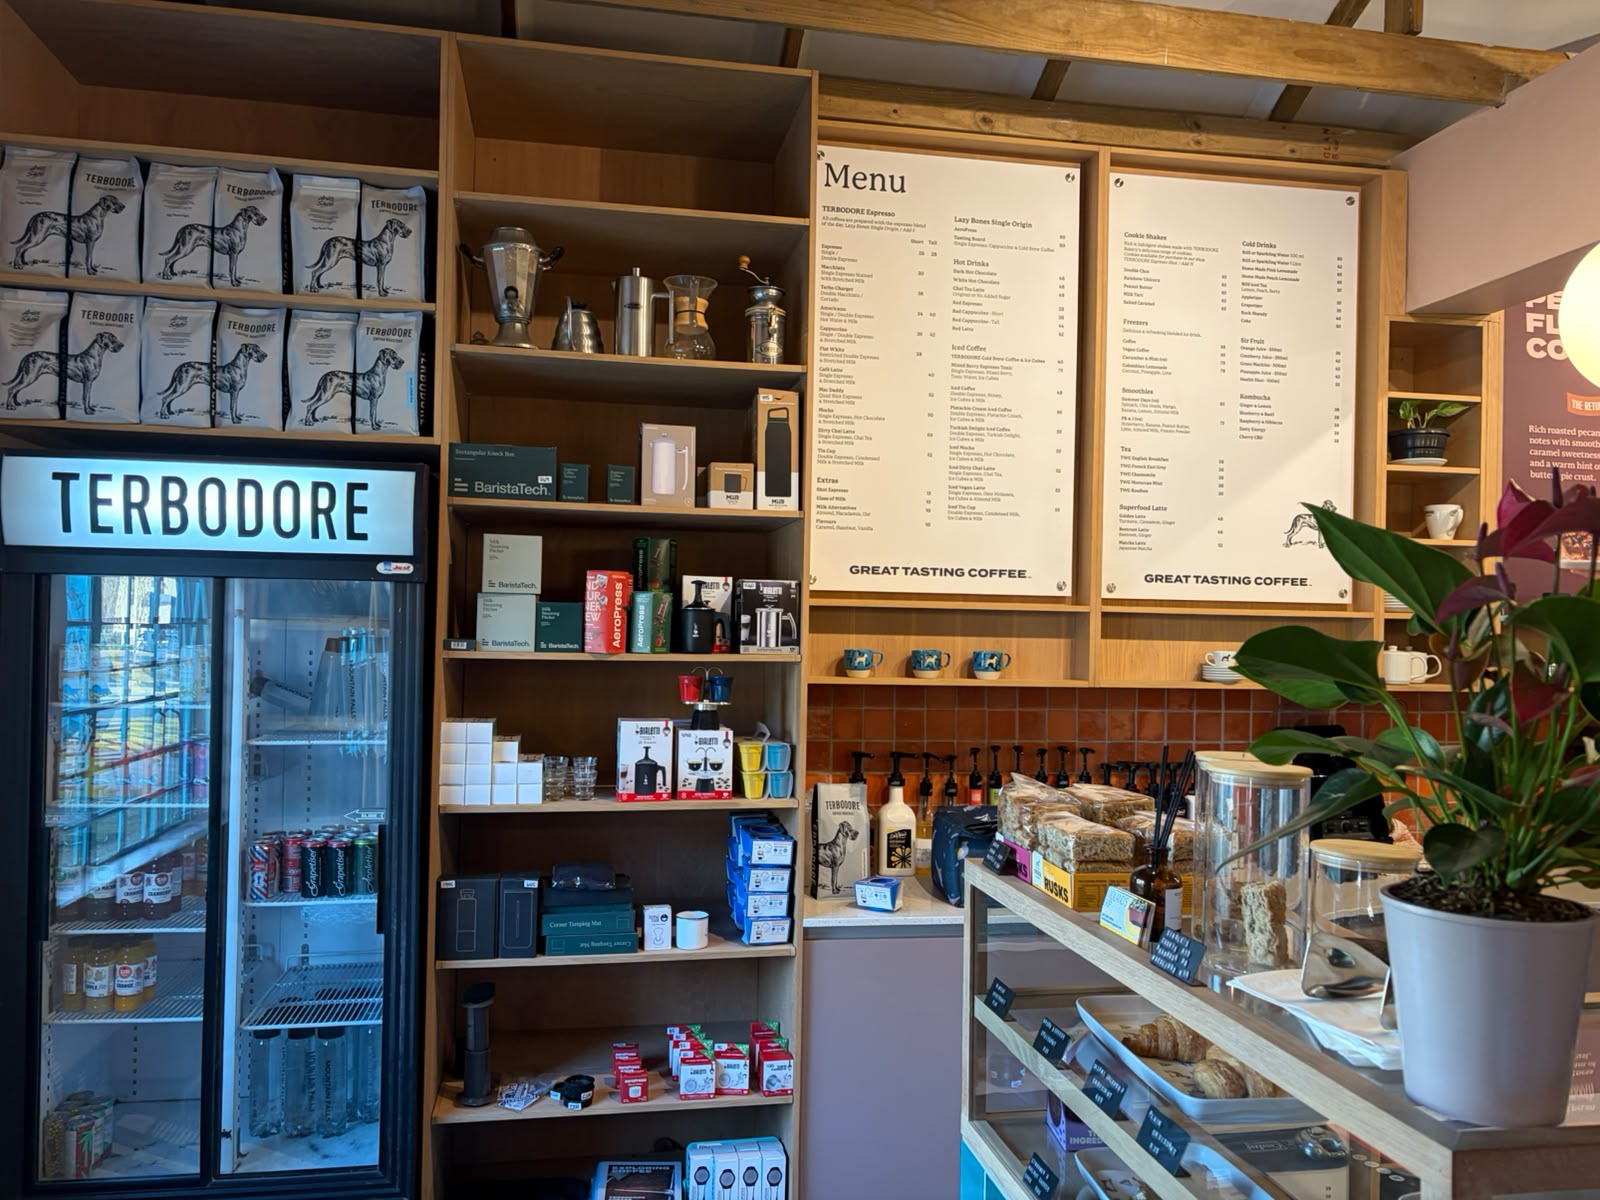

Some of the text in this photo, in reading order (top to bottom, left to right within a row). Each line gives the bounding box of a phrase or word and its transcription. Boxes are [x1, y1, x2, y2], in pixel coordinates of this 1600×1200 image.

[85, 173, 136, 188] TERBODORE
[825, 163, 906, 193] Menu
[226, 183, 276, 197] TERBODORE
[371, 200, 418, 212] TERBODORE
[822, 206, 895, 217] TERBODORE Espresso
[954, 216, 969, 224] Lazy
[991, 219, 1010, 227] Single
[81, 309, 135, 323] TERBODORE
[227, 320, 277, 333] TERBODORE
[365, 327, 413, 338] TERBODORE
[1526, 337, 1568, 360] CO
[1572, 399, 1583, 410] THE
[1529, 424, 1546, 434] Rich
[1548, 427, 1576, 436] roasted
[1552, 438, 1571, 447] with
[1529, 449, 1560, 457] caramel
[1530, 459, 1545, 468] and
[1552, 461, 1576, 469] warm
[1577, 461, 1593, 470] hint
[1561, 471, 1573, 481] pie
[1574, 474, 1597, 482] crust.
[474, 481, 551, 496] BaristaTech.
[51, 472, 369, 541] TERBODORE
[849, 565, 900, 575] GREAT
[902, 567, 965, 577] TASTING
[498, 581, 537, 589] BaristaTech.
[1144, 574, 1191, 583] GREAT
[1193, 575, 1252, 585] TASTING
[612, 582, 622, 648] AeroPress
[637, 605, 645, 647] AeroPress
[640, 726, 660, 735] BIALETTI
[698, 737, 718, 745] BIALETTI
[825, 800, 861, 811] TERBODORE
[306, 848, 318, 897] Grapetiser
[333, 848, 345, 897] Grapetiser
[1044, 877, 1069, 904] RUSKS
[569, 921, 591, 930] Tamping
[590, 939, 613, 947] Tamping
